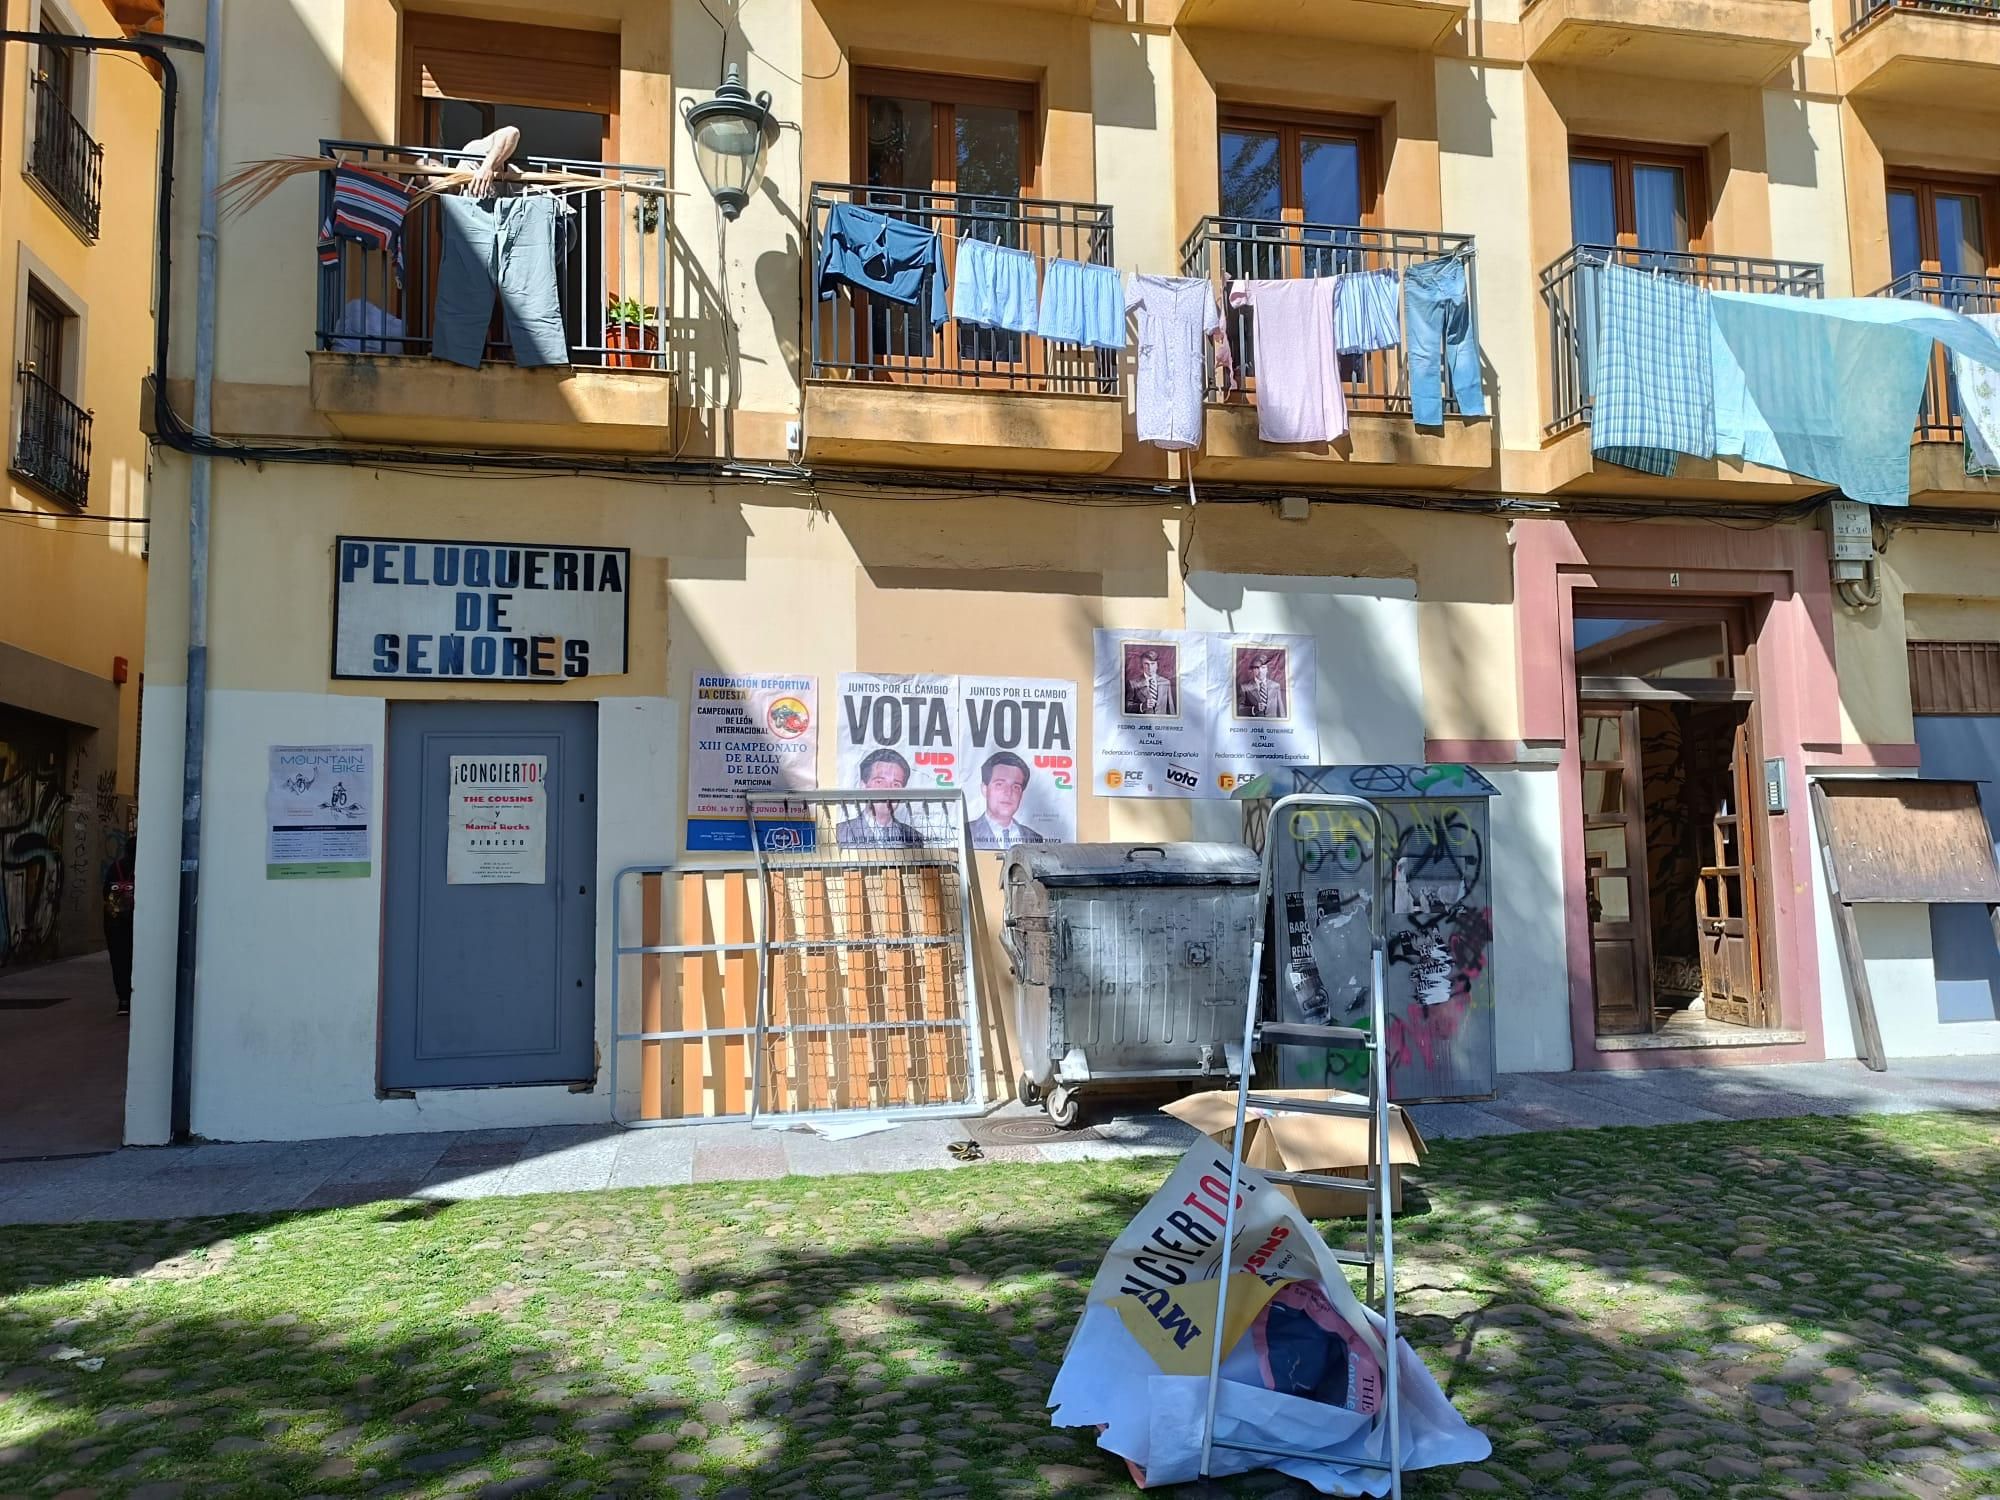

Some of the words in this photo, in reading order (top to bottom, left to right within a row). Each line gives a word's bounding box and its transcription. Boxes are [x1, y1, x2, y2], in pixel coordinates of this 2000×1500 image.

[342, 543, 623, 593] PELUQUERIA
[455, 592, 513, 632] DE
[699, 677, 758, 689] AGRUPACIÓN
[761, 679, 811, 691] DEPORTIVA
[848, 683, 880, 693] JUNTOS
[883, 684, 901, 694] POR
[903, 684, 912, 694] EL
[915, 685, 949, 695] CAMBIO
[699, 690, 710, 700] LA
[713, 690, 747, 701] CUESTA
[969, 687, 1001, 697] JUNTOS
[1003, 687, 1021, 697] POR
[1023, 688, 1032, 698] EL
[1034, 689, 1067, 699] CAMBIO
[697, 707, 744, 716] CAMPEONATO
[725, 717, 735, 725] DE
[736, 715, 753, 725] LEÓN
[844, 695, 953, 747] VOTA
[965, 699, 1071, 751] VOTA
[715, 726, 769, 735] INTERNACIONAL
[699, 741, 721, 751] XIII
[725, 742, 808, 753] CAMPEONATO
[280, 755, 363, 765] MOUNTAIN
[725, 753, 743, 763] DE
[745, 754, 782, 764] RALLY
[1102, 749, 1133, 757] Federación
[1134, 750, 1173, 758] Conservadora
[1173, 751, 1199, 759] Española
[1215, 752, 1246, 760] Federación
[1284, 753, 1310, 761] Española
[332, 764, 365, 773] BIKE
[455, 763, 542, 784] ¡CONCIERTO!
[727, 765, 744, 774] DE
[747, 763, 779, 775] LEÓN
[1124, 771, 1144, 780] FCE
[1361, 1375, 1375, 1413] THE
